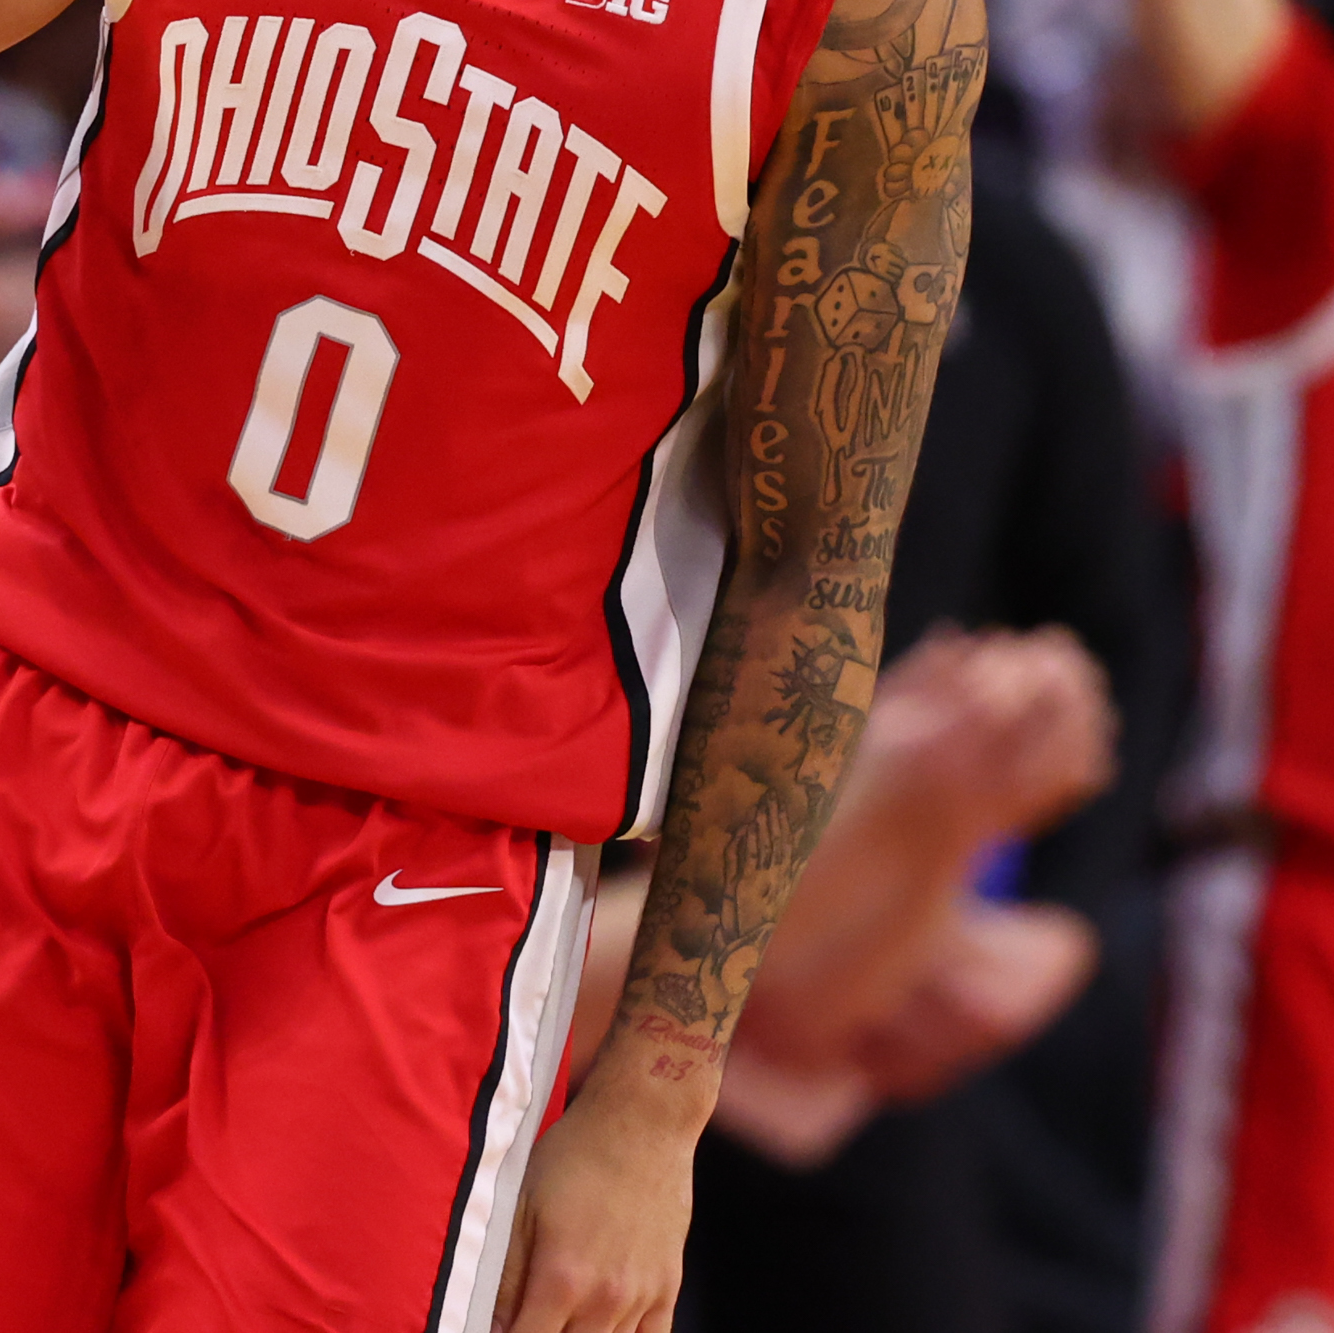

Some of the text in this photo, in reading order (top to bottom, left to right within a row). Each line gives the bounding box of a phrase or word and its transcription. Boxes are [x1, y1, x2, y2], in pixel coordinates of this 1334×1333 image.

[132, 11, 668, 405] OHIO STATE
[750, 107, 856, 560] Fearless
[226, 294, 400, 543] 0
